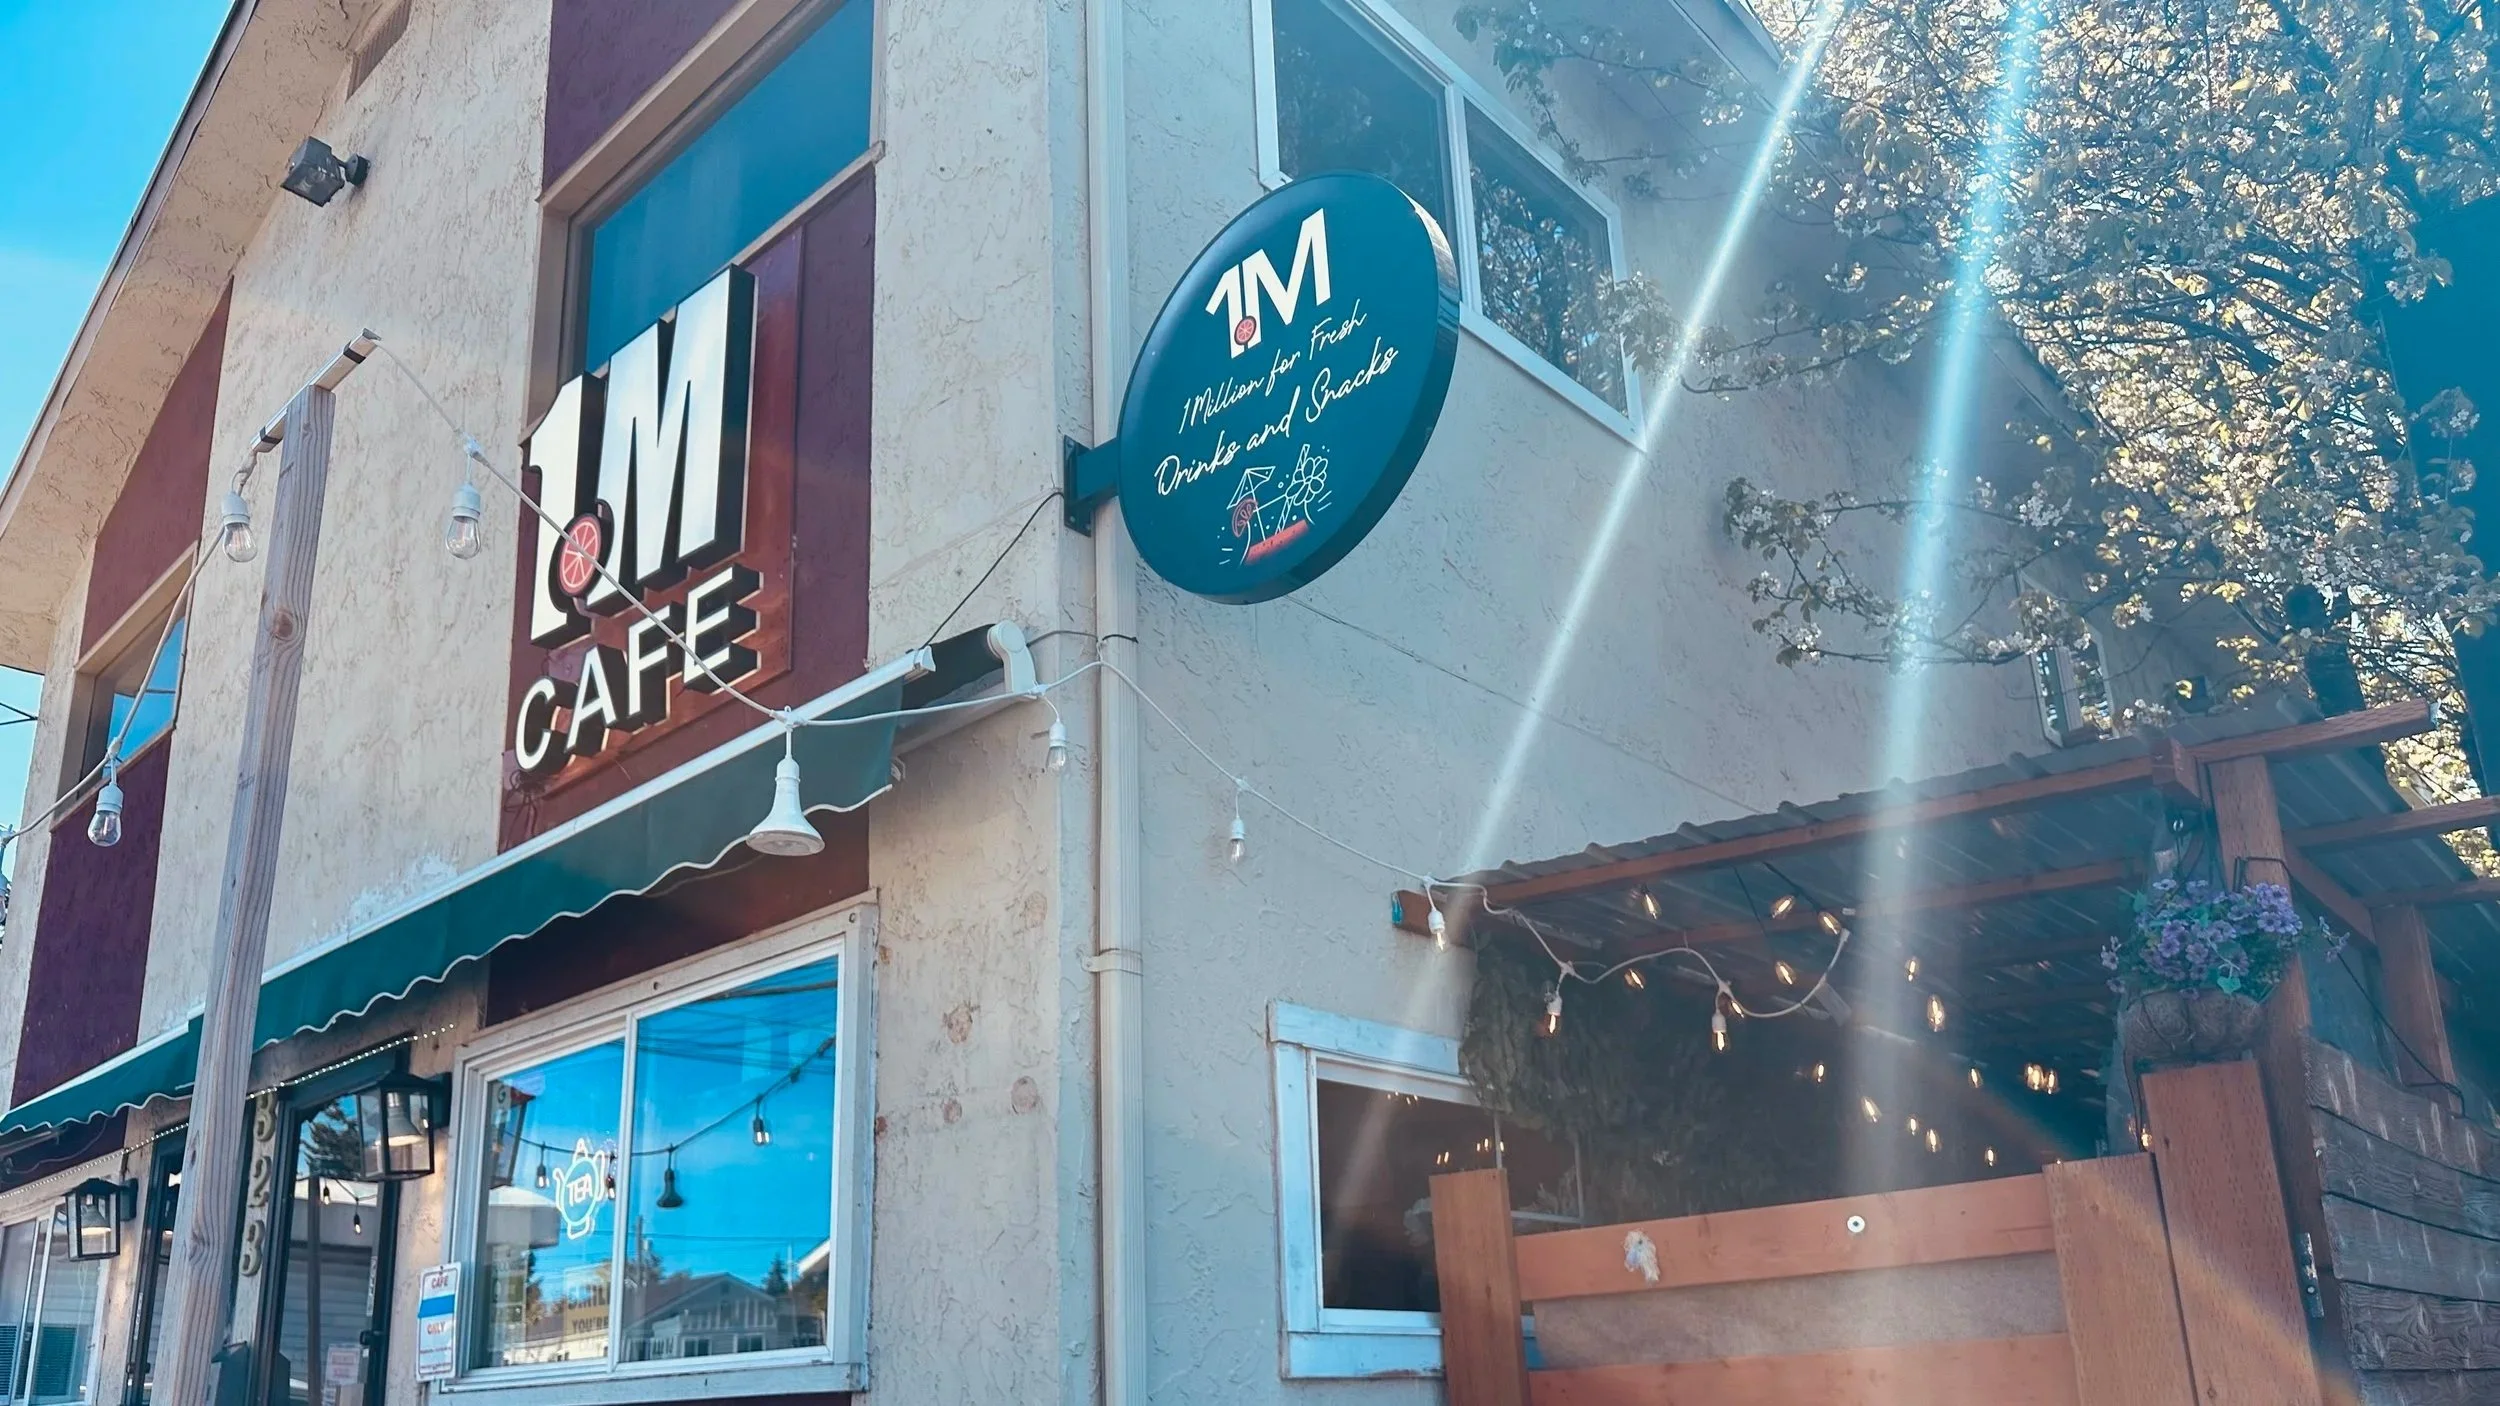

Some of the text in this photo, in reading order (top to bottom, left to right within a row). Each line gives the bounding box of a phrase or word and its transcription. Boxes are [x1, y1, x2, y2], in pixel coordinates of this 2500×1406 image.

[1204, 207, 1331, 359] 1M
[1264, 348, 1301, 397] for
[1308, 298, 1367, 361] Fresh
[527, 266, 738, 646] 1M
[1153, 336, 1399, 496] Drinks and Snacks
[514, 565, 736, 773] CAFE
[566, 1172, 594, 1207] TEA
